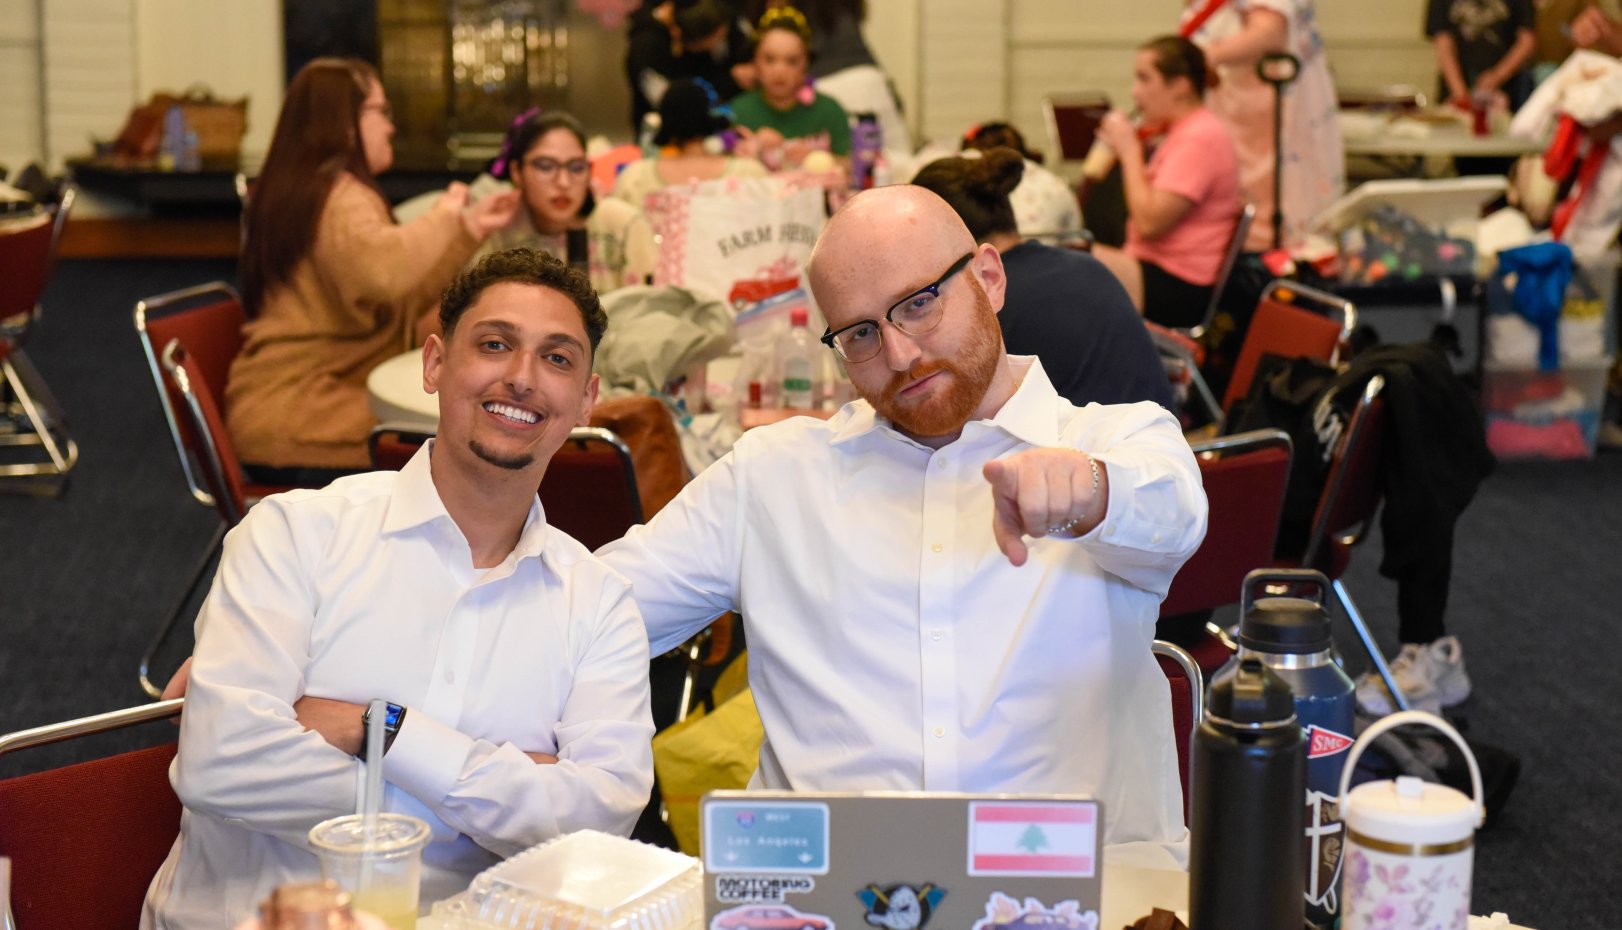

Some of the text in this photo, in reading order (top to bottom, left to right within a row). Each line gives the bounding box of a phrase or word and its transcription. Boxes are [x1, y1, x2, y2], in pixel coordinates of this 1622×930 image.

[717, 224, 772, 258] FARM
[727, 837, 808, 848] Los Angeles
[720, 889, 781, 899] COFFEE
